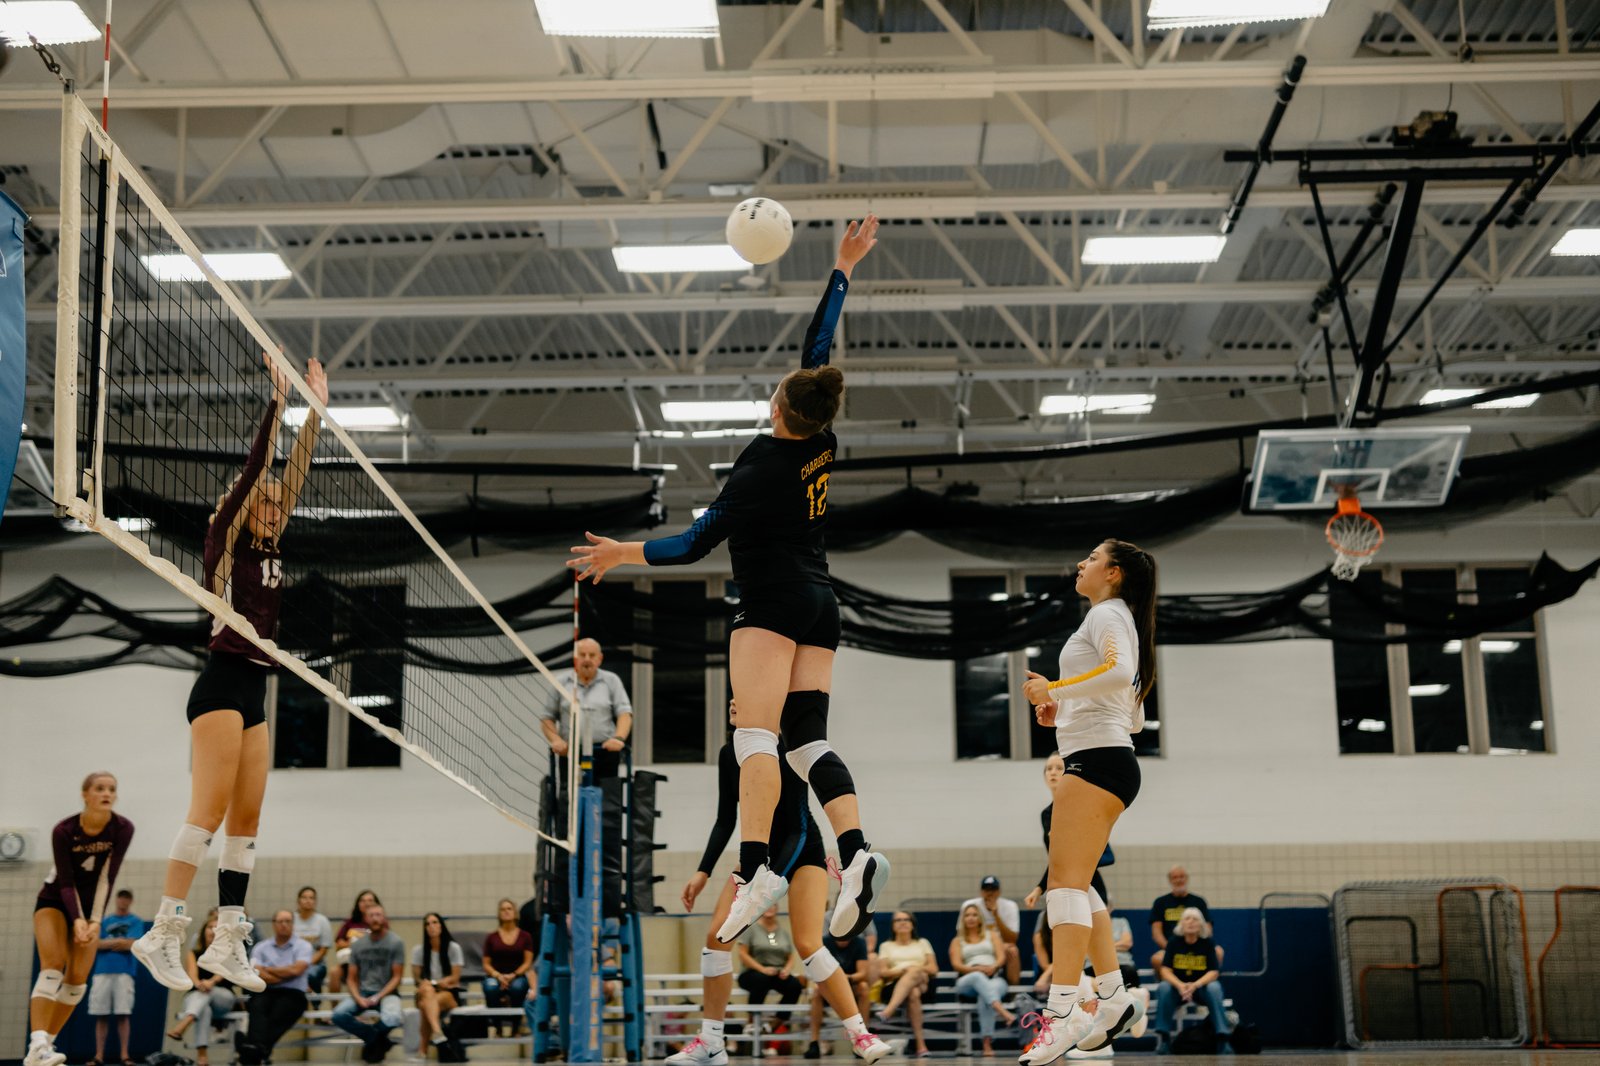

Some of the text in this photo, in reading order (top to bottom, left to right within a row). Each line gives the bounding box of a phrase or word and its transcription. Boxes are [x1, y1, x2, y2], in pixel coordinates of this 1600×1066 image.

[800, 449, 833, 481] CHARGERS
[806, 473, 831, 520] 12
[260, 558, 282, 589] 15
[80, 854, 97, 872] 4
